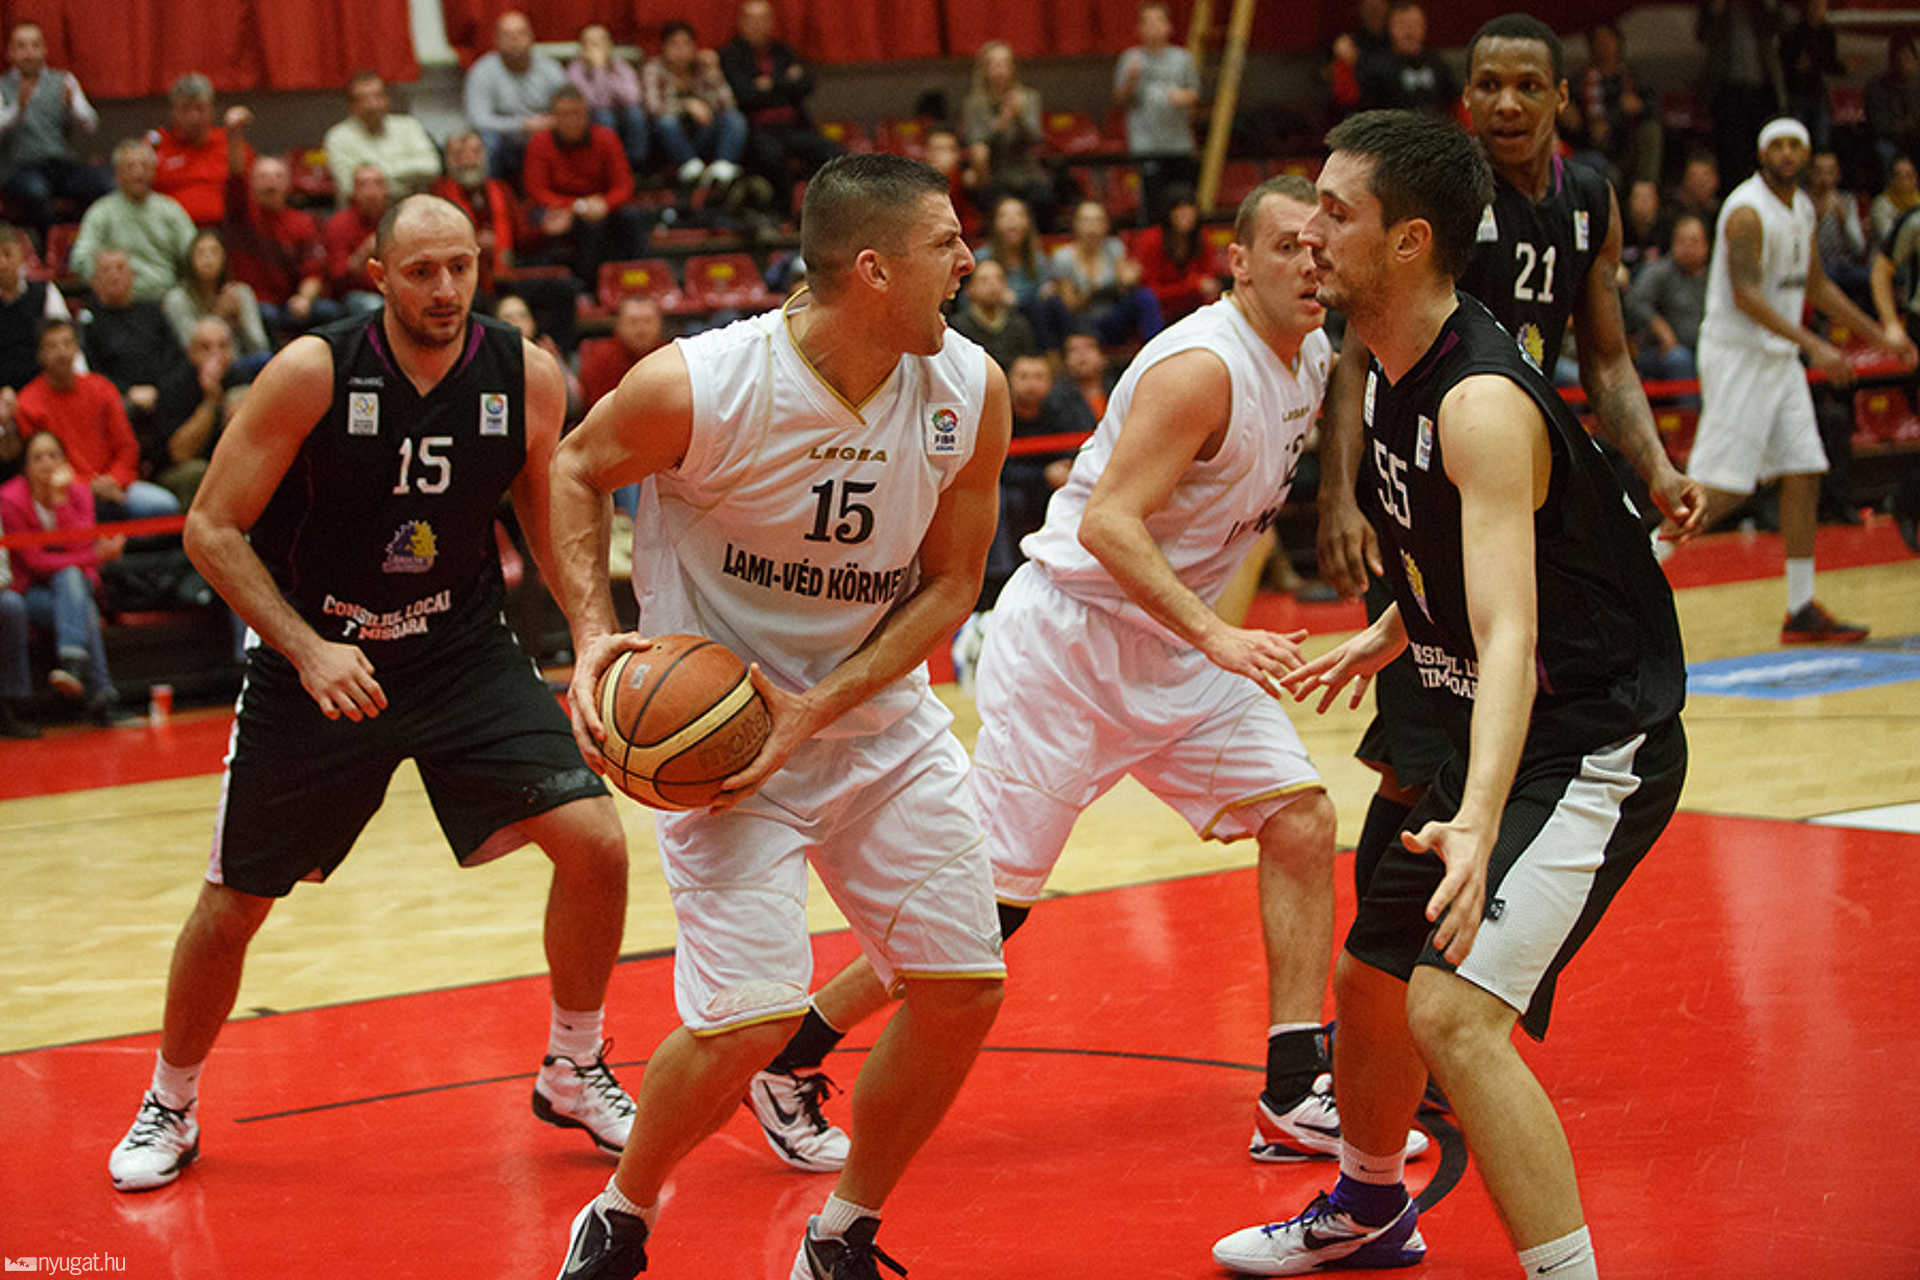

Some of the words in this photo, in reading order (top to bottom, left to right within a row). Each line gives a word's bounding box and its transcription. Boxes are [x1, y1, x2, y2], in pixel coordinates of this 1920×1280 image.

[1514, 242, 1556, 302] 21
[392, 437, 453, 494] 15
[808, 448, 887, 463] LEGEA
[1373, 437, 1411, 529] 55
[804, 479, 877, 544] 15
[722, 543, 823, 597] LAMI-VÉD
[826, 562, 907, 604] KÖRME
